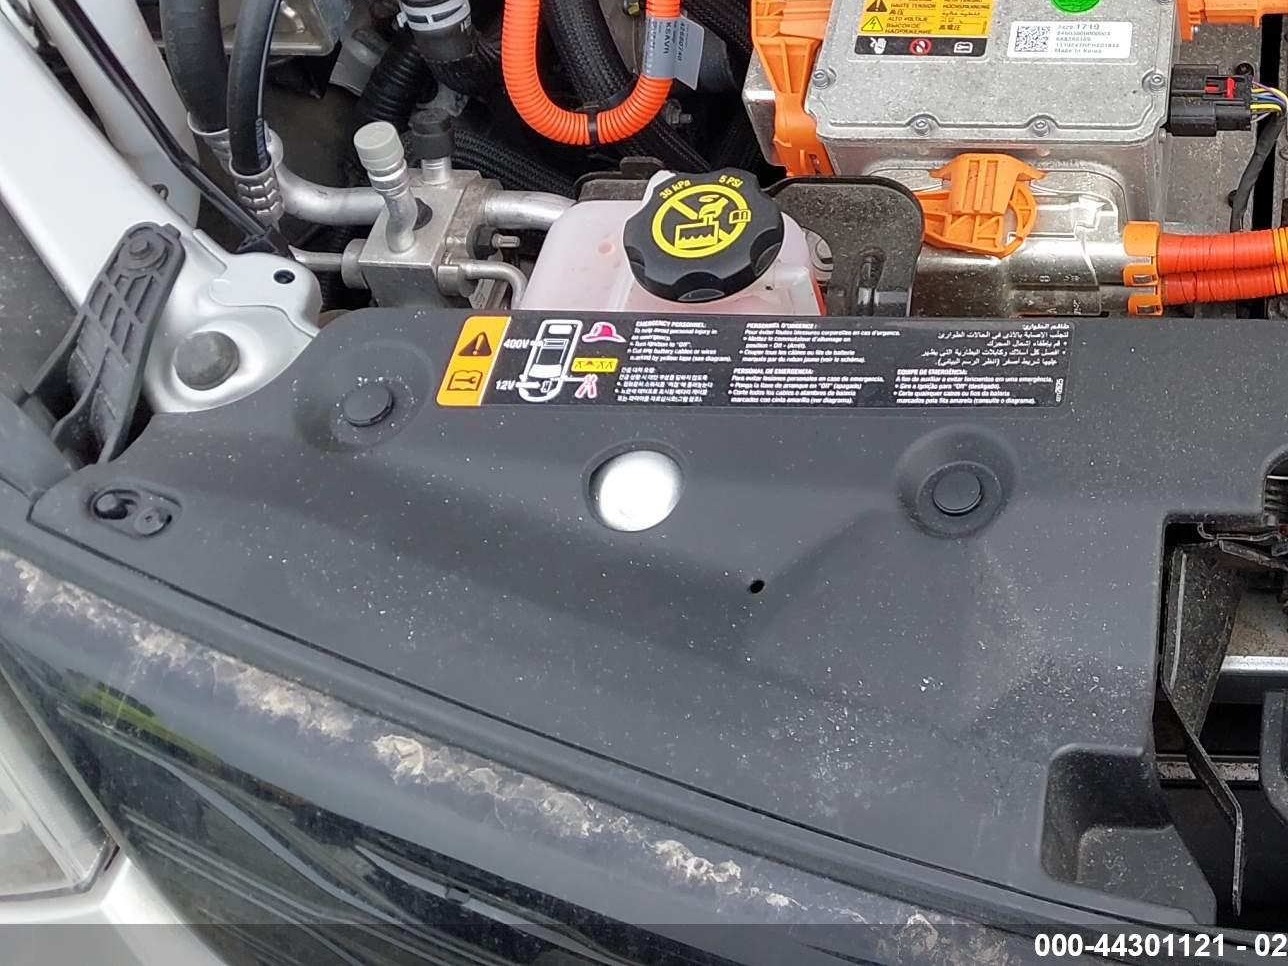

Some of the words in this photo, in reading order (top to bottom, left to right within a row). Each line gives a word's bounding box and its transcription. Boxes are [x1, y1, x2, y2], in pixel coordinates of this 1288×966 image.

[718, 175, 726, 183] 5
[727, 177, 743, 188] PSI
[659, 188, 671, 199] 35
[672, 180, 691, 193] kPa
[503, 339, 530, 348] 400V
[495, 379, 516, 390] 12V
